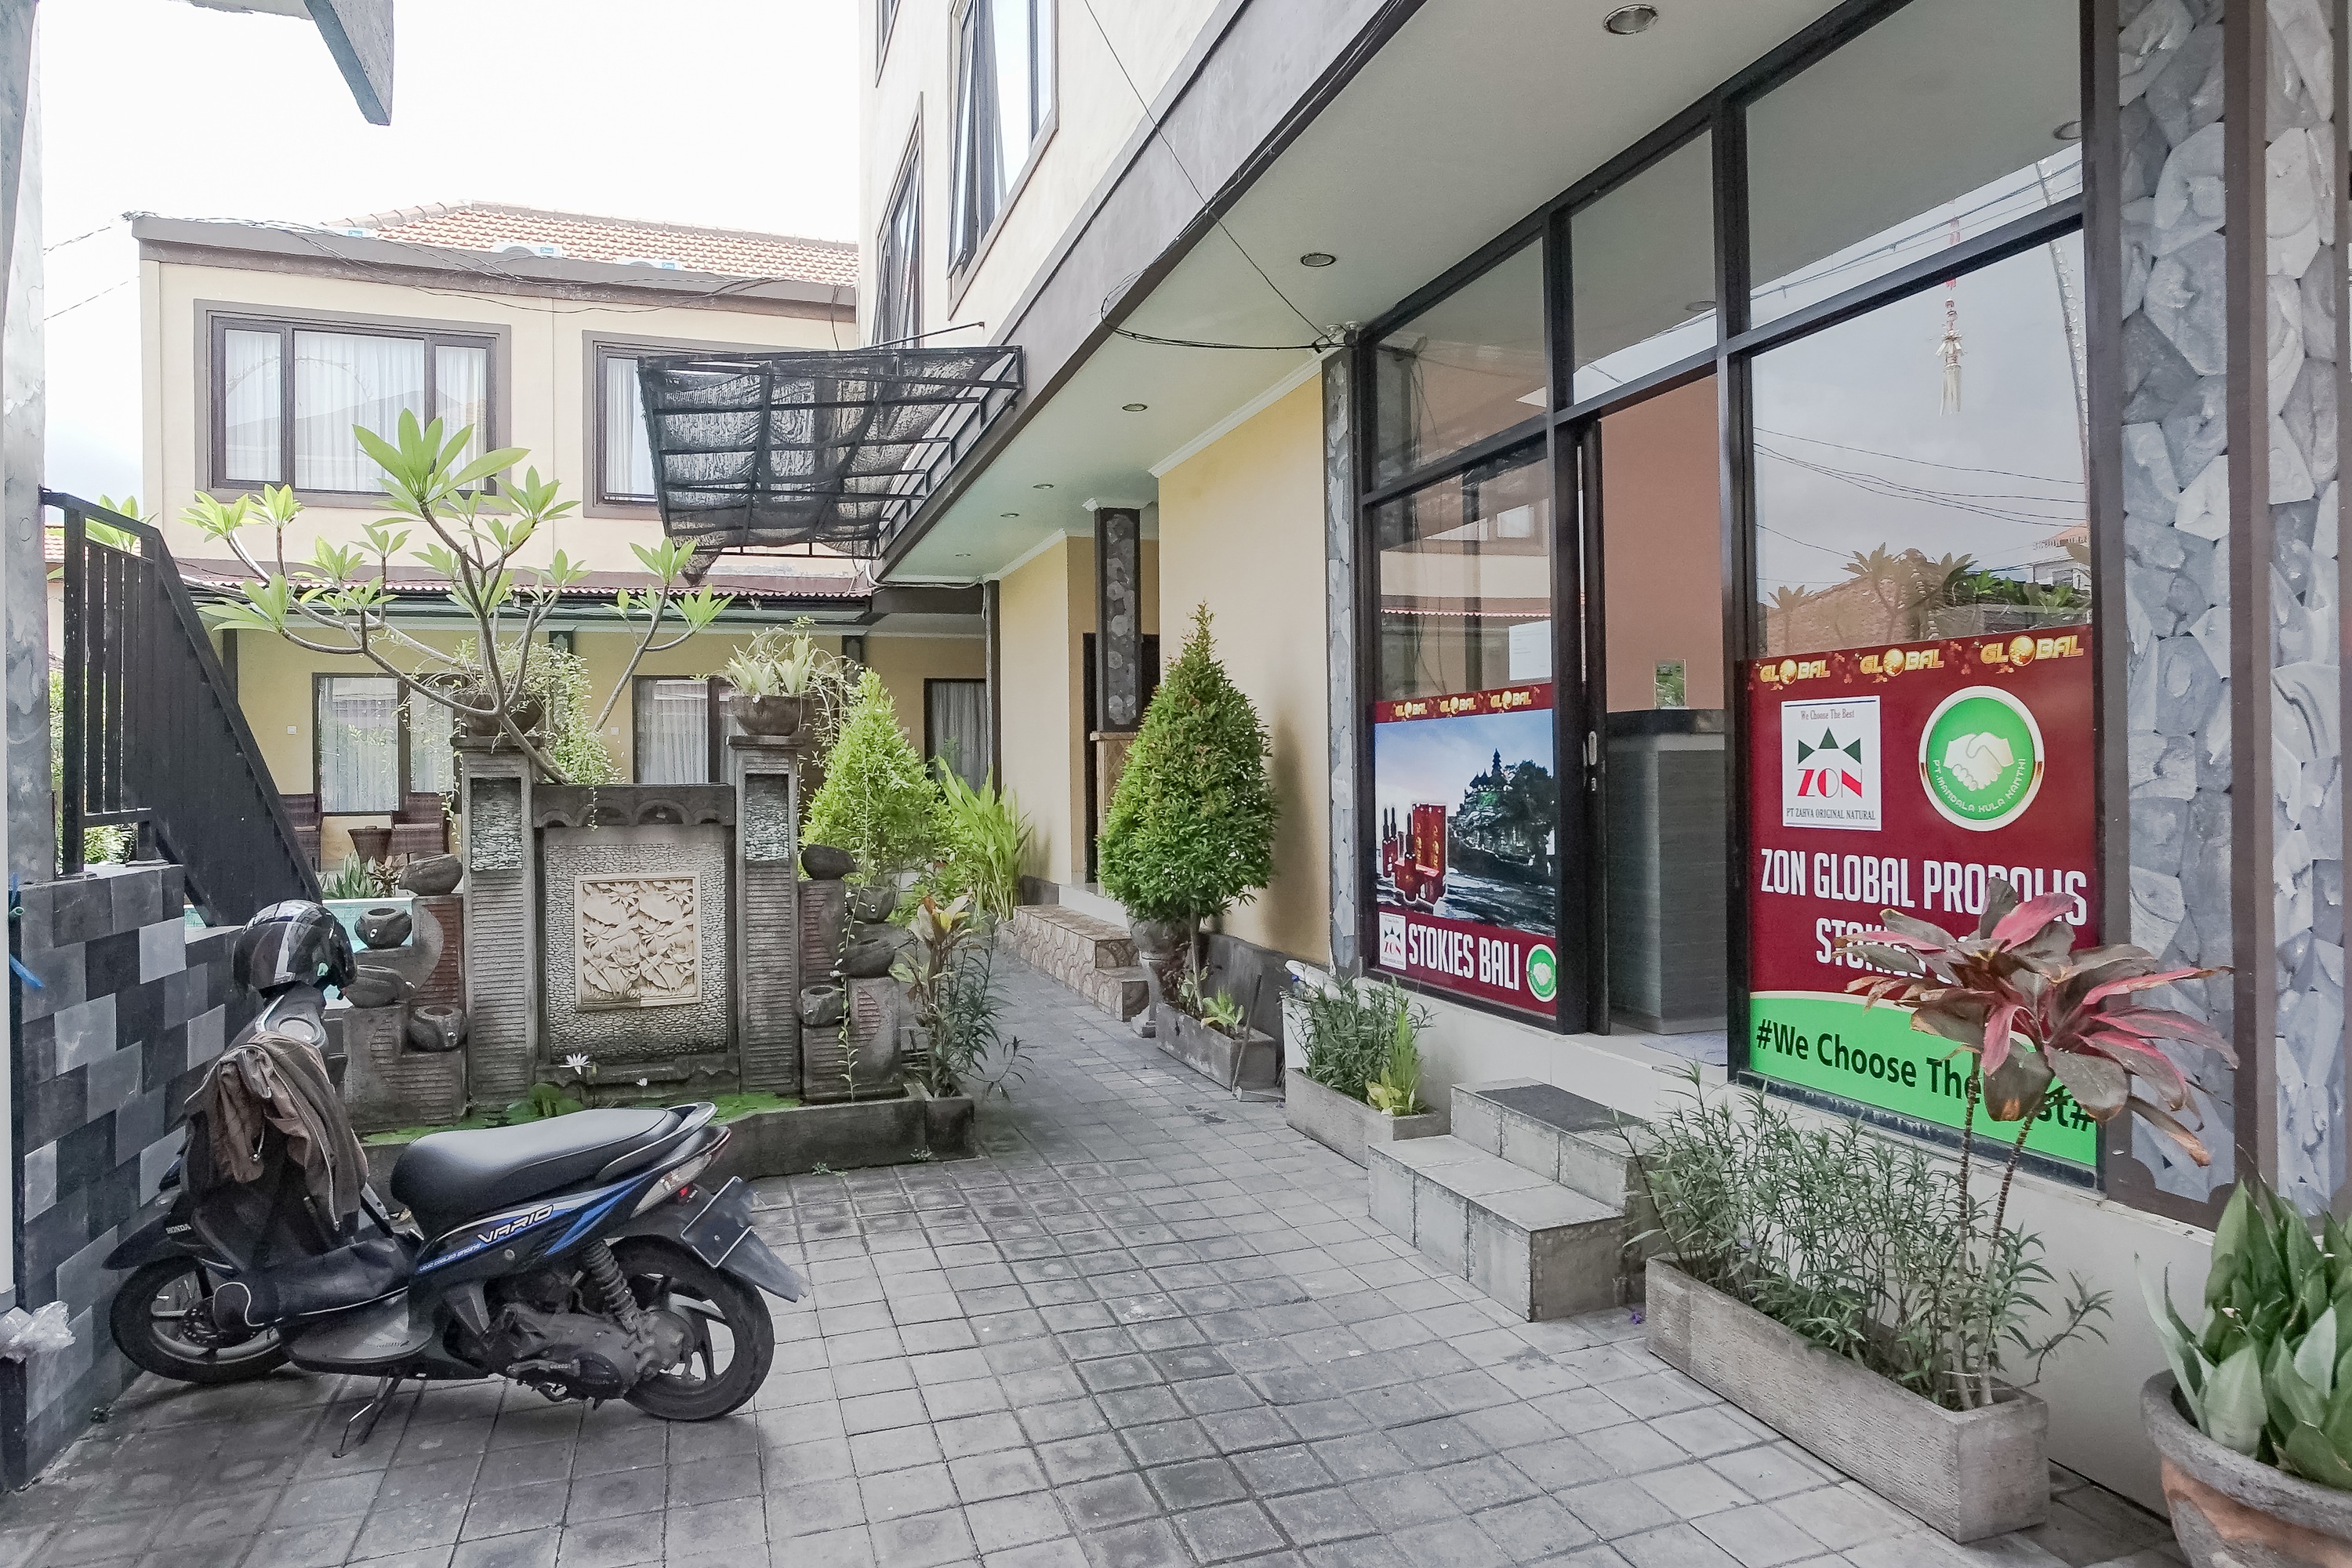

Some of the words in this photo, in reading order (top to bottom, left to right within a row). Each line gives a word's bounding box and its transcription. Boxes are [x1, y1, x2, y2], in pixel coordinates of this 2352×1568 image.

[1759, 659, 1831, 685] GLOBAL
[1860, 648, 1944, 677] GLOBAL
[1980, 635, 2085, 667] GLOBAL
[1395, 701, 1428, 719] GLOBAL
[1439, 696, 1477, 715] GLOBAL
[1490, 691, 1532, 710] GLOBAL
[1810, 710, 1829, 720] Choose
[1830, 709, 1841, 719] The
[1842, 708, 1855, 719] Best
[1797, 768, 1864, 799] ZON
[1787, 808, 1795, 817] PT
[1816, 808, 1845, 819] ORIGINAL
[1846, 810, 1876, 821] NATURAL
[1761, 848, 1806, 896] ZON
[1813, 852, 1915, 908] GLOBAL
[1408, 923, 1475, 979] STOKIES
[1479, 936, 1519, 991] BALI
[1755, 1019, 1809, 1060] #We
[1817, 1033, 1917, 1087] Choose
[165, 1223, 192, 1235] HONDA
[477, 1204, 554, 1243] VARIO
